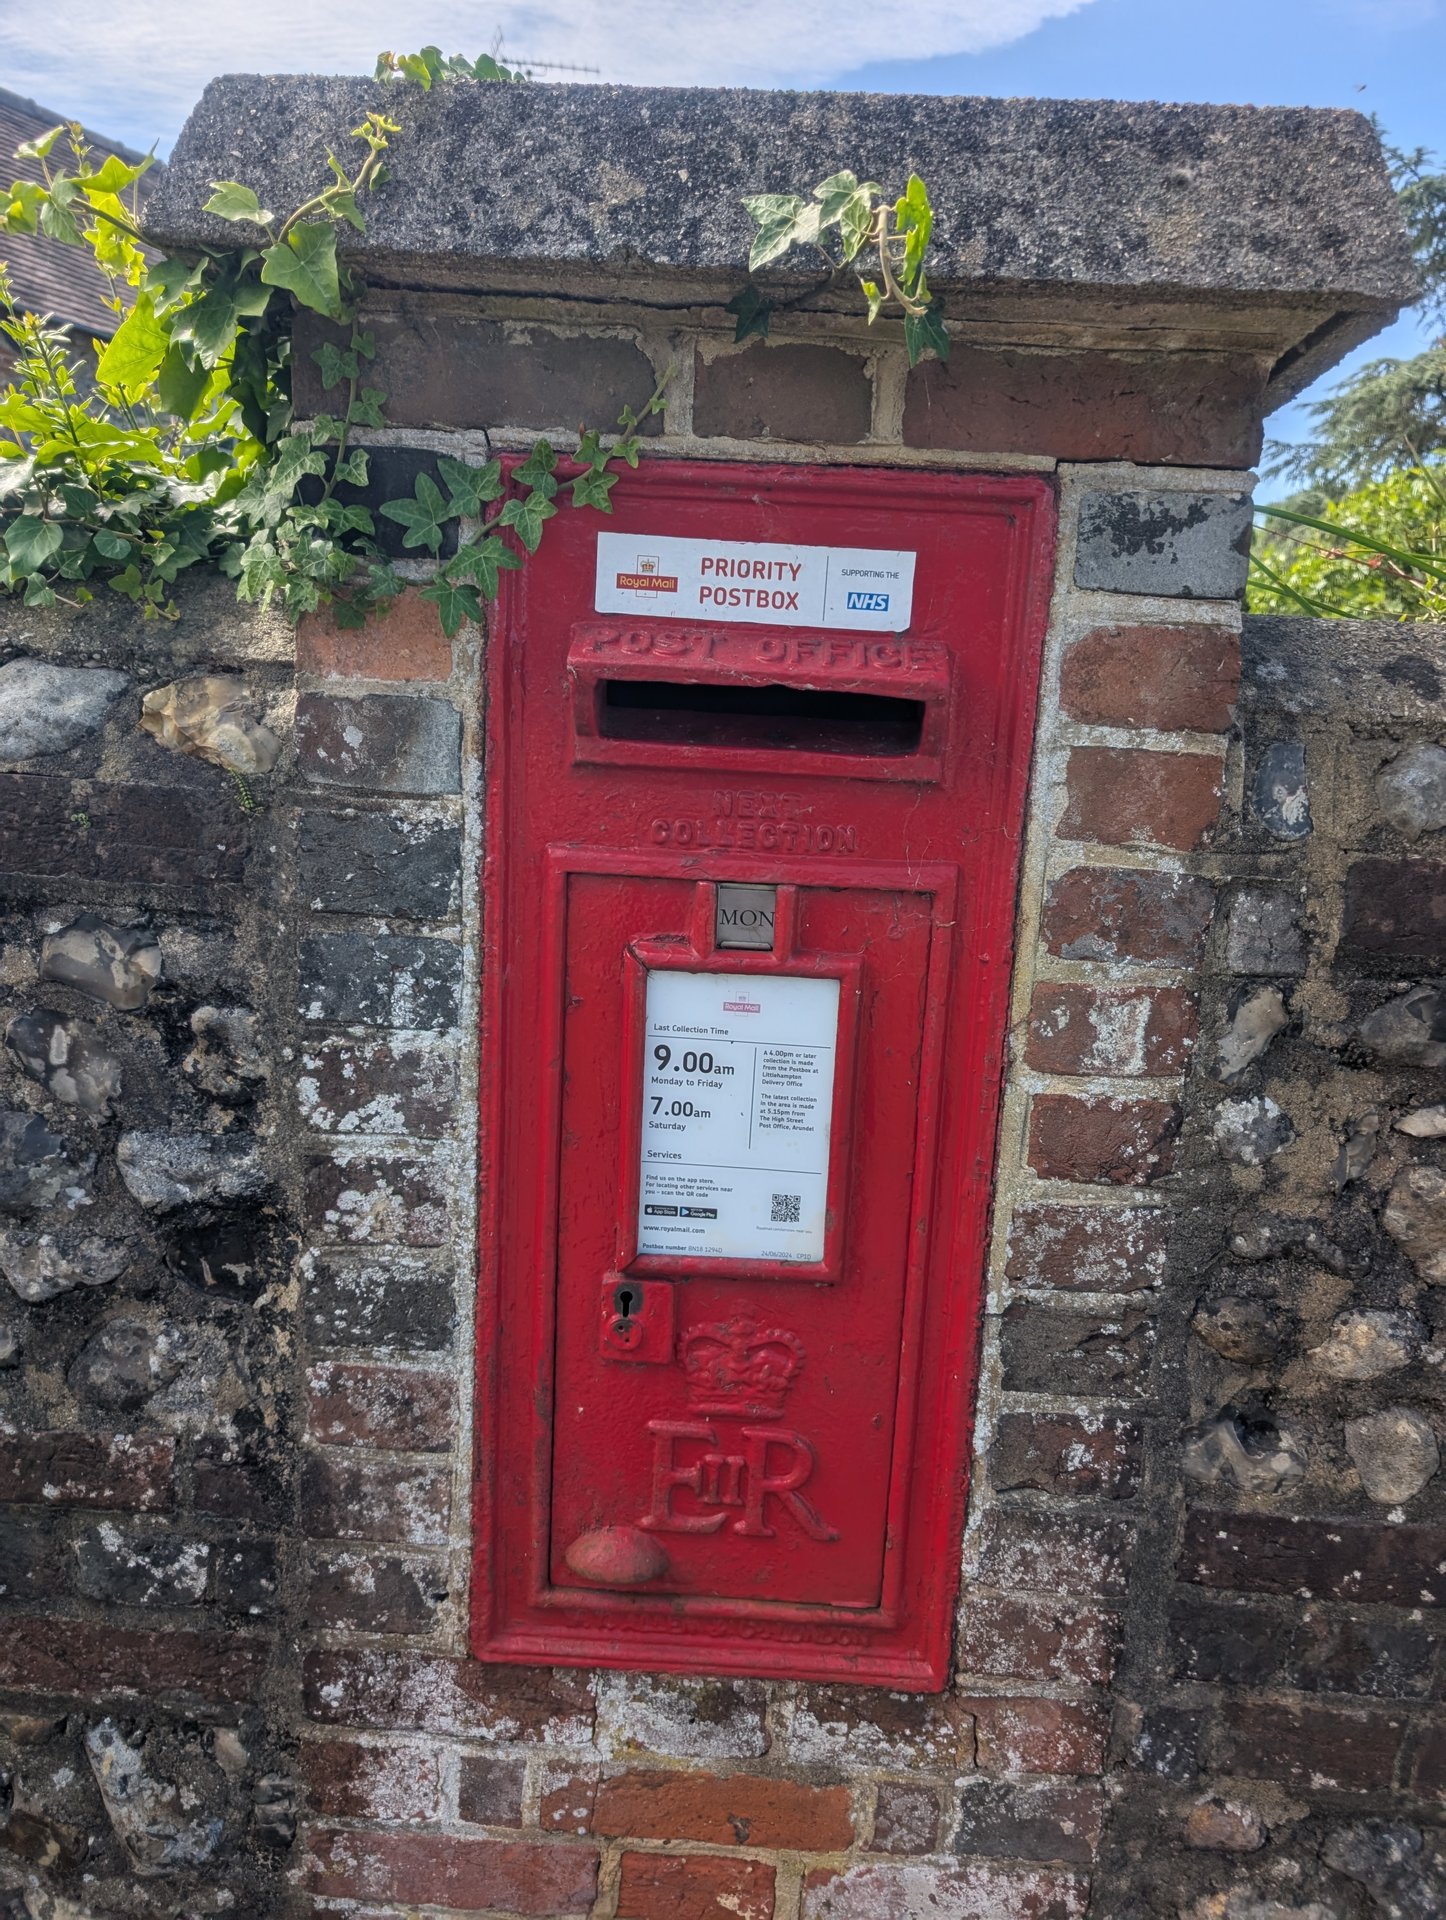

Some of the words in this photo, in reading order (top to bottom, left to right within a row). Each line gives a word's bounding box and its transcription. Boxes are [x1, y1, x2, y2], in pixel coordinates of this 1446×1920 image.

[701, 557, 802, 581] PRIORITY
[841, 568, 884, 580] SUPPORTING
[886, 571, 900, 580] THE
[619, 576, 650, 588] Royal
[650, 578, 675, 589] Mail
[699, 586, 800, 611] POSTBOX
[848, 593, 889, 611] NHS
[584, 629, 728, 660] POST
[755, 637, 938, 671] OFFICE
[712, 790, 803, 820] NEXT
[651, 818, 857, 853] COLLECTION
[719, 908, 775, 929] MON
[724, 1002, 744, 1011] Royal
[654, 1023, 670, 1032] Last
[672, 1024, 708, 1034] Collection
[710, 1027, 729, 1036] Time
[654, 1044, 735, 1075] 9.00am
[769, 1050, 794, 1058] 4.00pm
[651, 1076, 684, 1087] Monday
[686, 1078, 694, 1086] to
[697, 1079, 723, 1089] Friday
[762, 1072, 802, 1080] Littlehampton
[650, 1096, 711, 1119] 7.00am
[767, 1108, 790, 1116] 5.15pm
[648, 1120, 686, 1132] Saturday
[772, 1123, 791, 1132] Office,
[647, 1150, 682, 1160] Services
[656, 1182, 678, 1190] locating
[644, 1226, 706, 1234] www.royalmail.com
